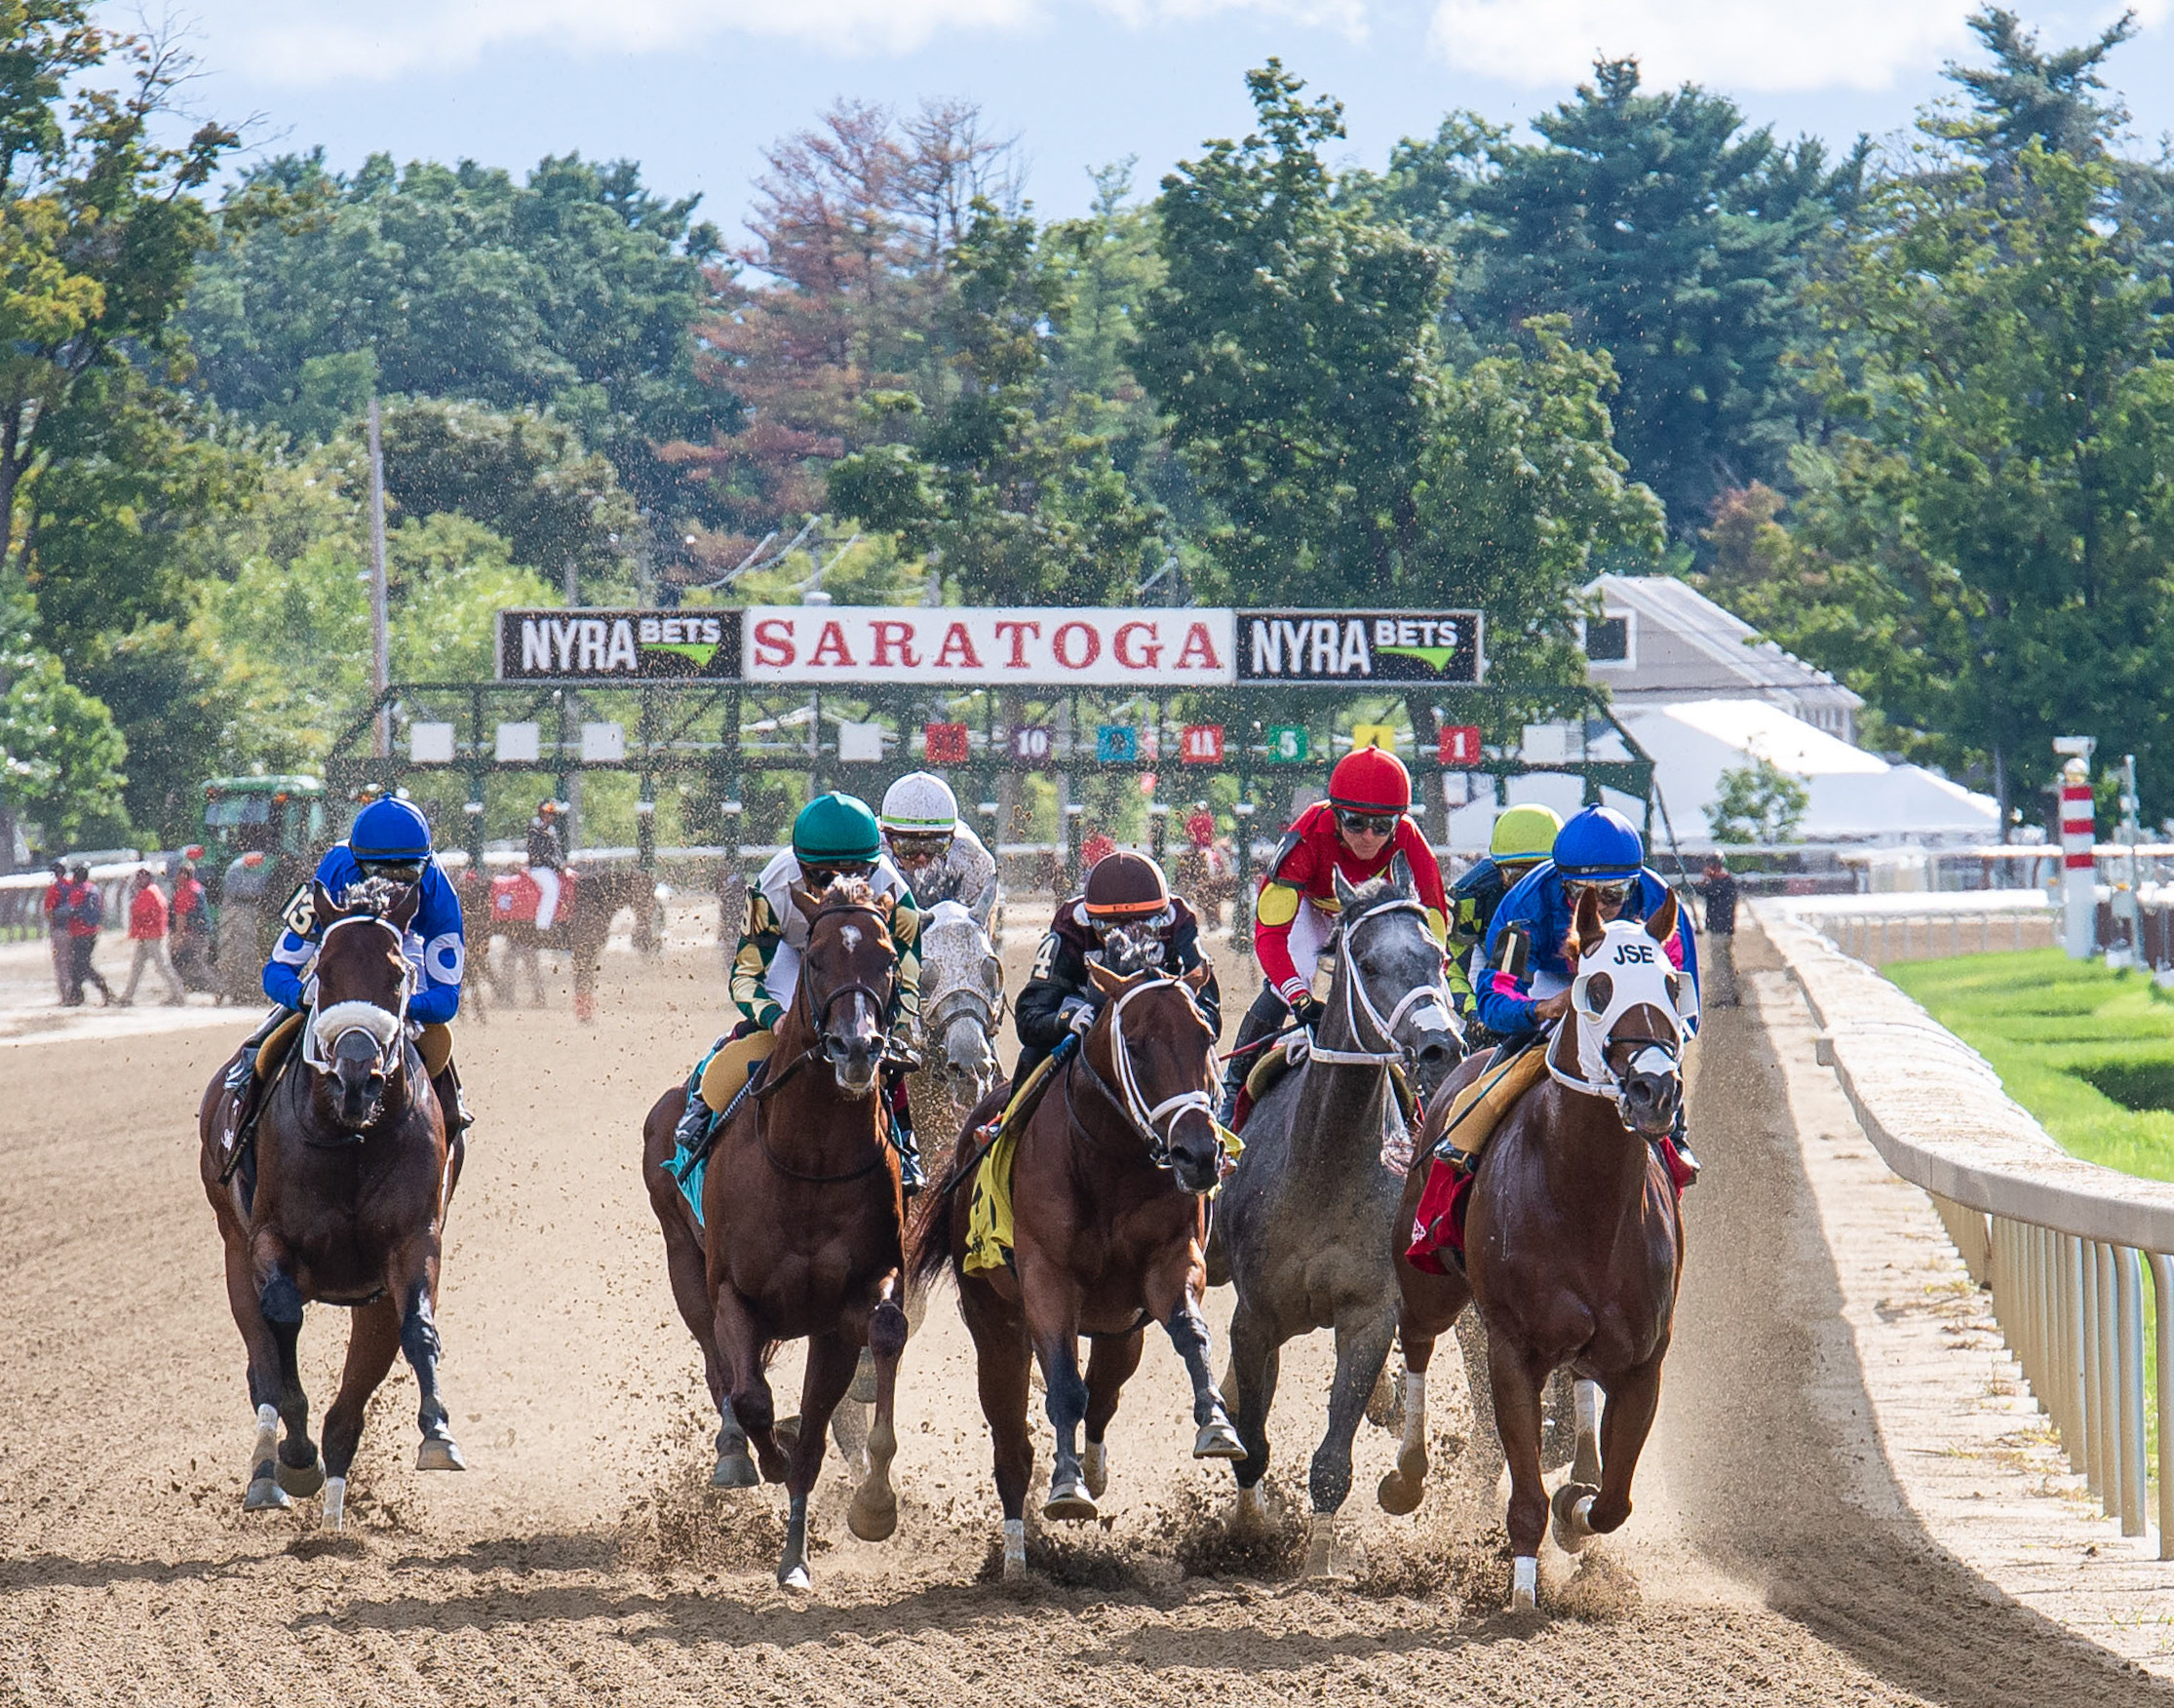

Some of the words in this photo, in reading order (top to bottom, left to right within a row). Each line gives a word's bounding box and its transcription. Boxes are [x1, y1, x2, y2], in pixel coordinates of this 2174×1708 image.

[522, 620, 638, 671] NYRA
[640, 618, 721, 644] BETS
[755, 620, 1224, 669] SARATOGA
[1252, 620, 1371, 674] NYRA
[1376, 620, 1458, 647] BETS
[1018, 729, 1047, 757] 10
[1280, 730, 1299, 757] 5
[1453, 732, 1466, 757] 1
[1033, 938, 1056, 979] 4
[1613, 945, 1654, 965] JSE
